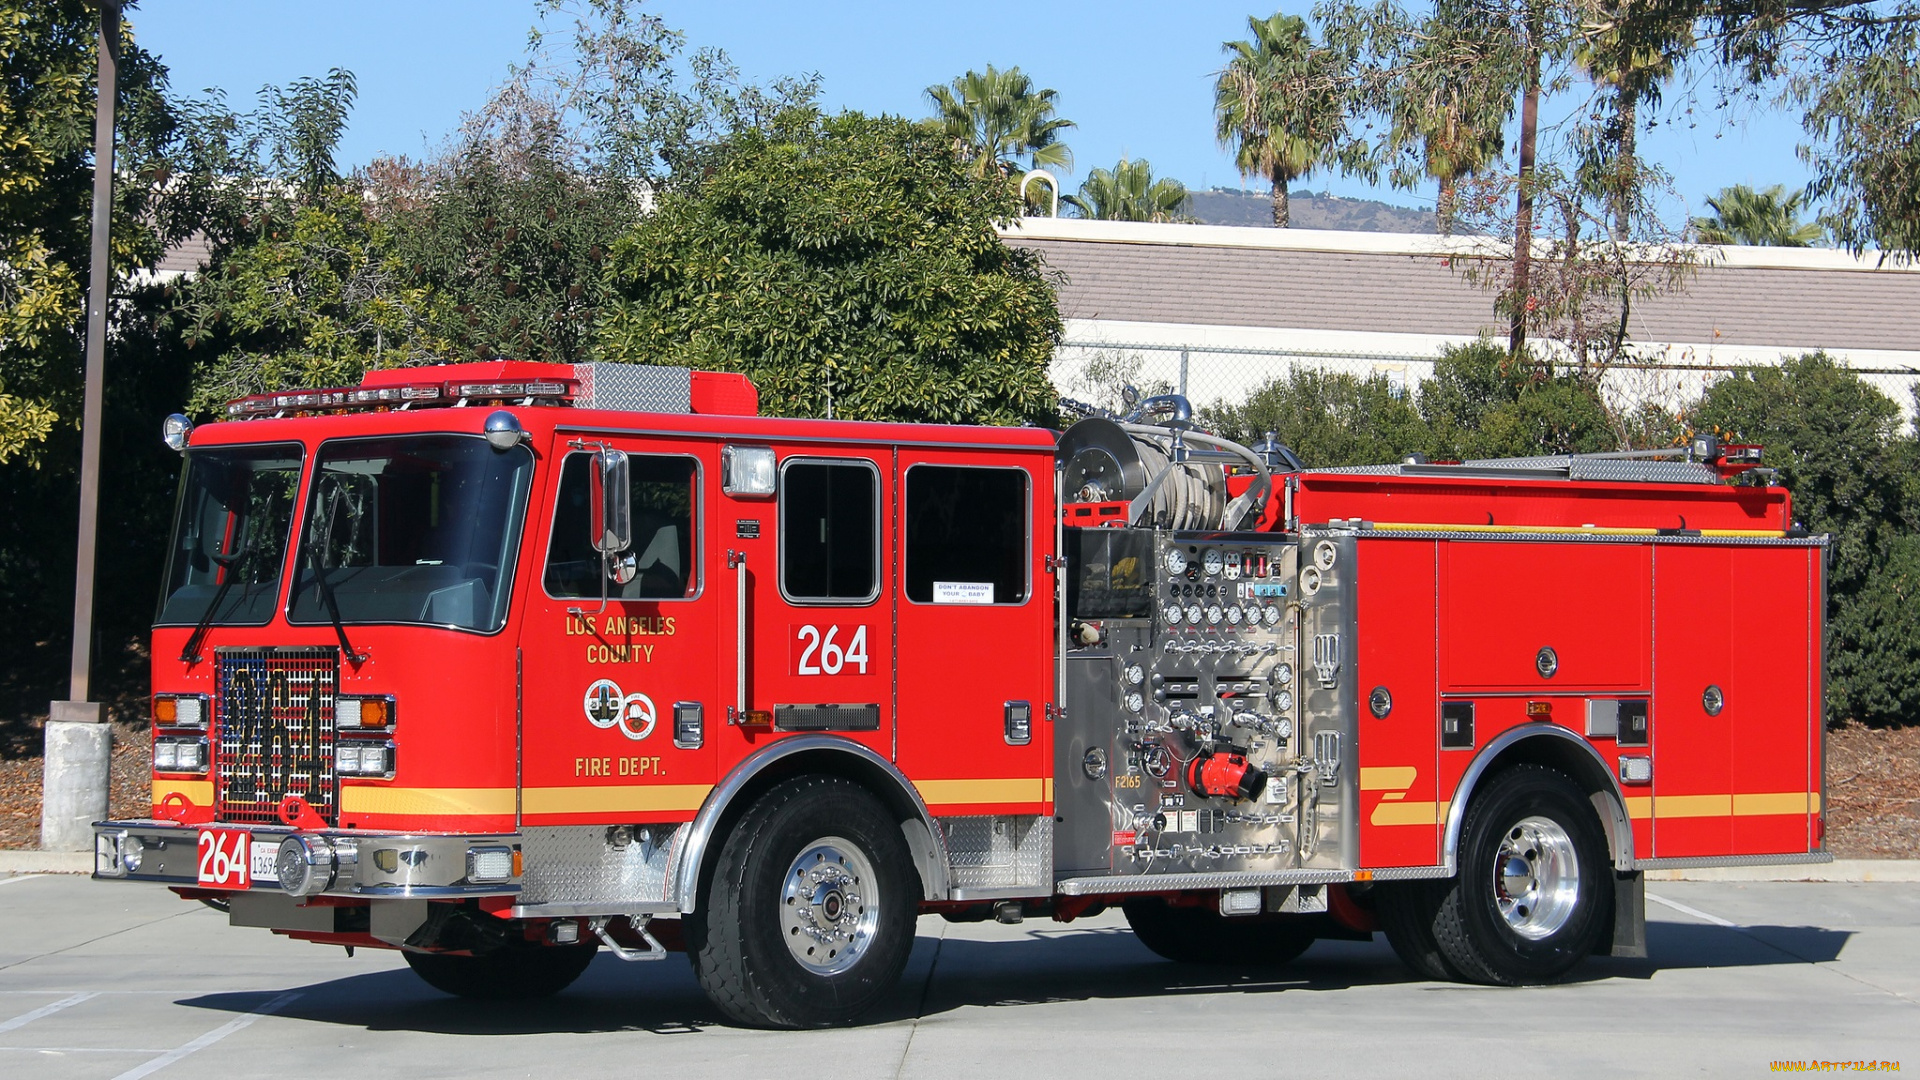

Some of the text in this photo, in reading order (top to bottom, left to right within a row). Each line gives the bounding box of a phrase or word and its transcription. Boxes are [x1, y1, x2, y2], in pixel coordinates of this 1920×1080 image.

[565, 616, 676, 636] LOS ANGELES
[586, 644, 655, 664] COUNTY
[797, 624, 869, 676] 264
[575, 756, 667, 777] FIRE DEPT.
[1115, 775, 1141, 788] F2165
[198, 830, 246, 885] 264
